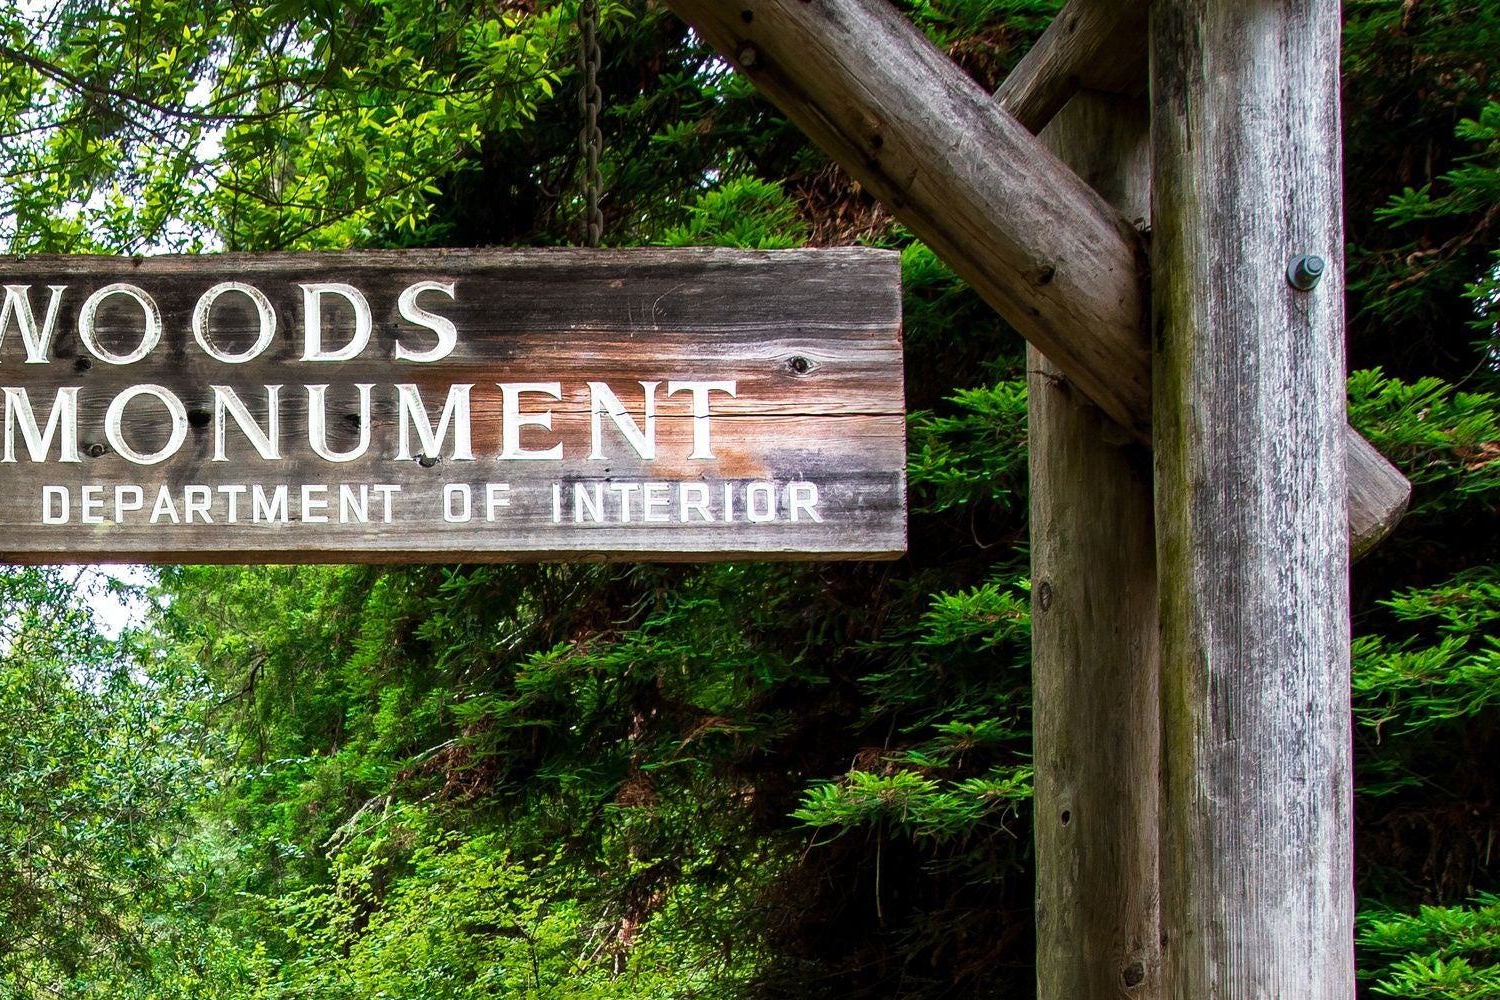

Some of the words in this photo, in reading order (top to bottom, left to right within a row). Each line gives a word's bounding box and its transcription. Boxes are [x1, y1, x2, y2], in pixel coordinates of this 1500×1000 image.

[0, 380, 738, 464] MONUMENT
[42, 484, 401, 526] DEPARTMENT
[443, 483, 512, 524] OF
[552, 481, 824, 525] INTERIOR
